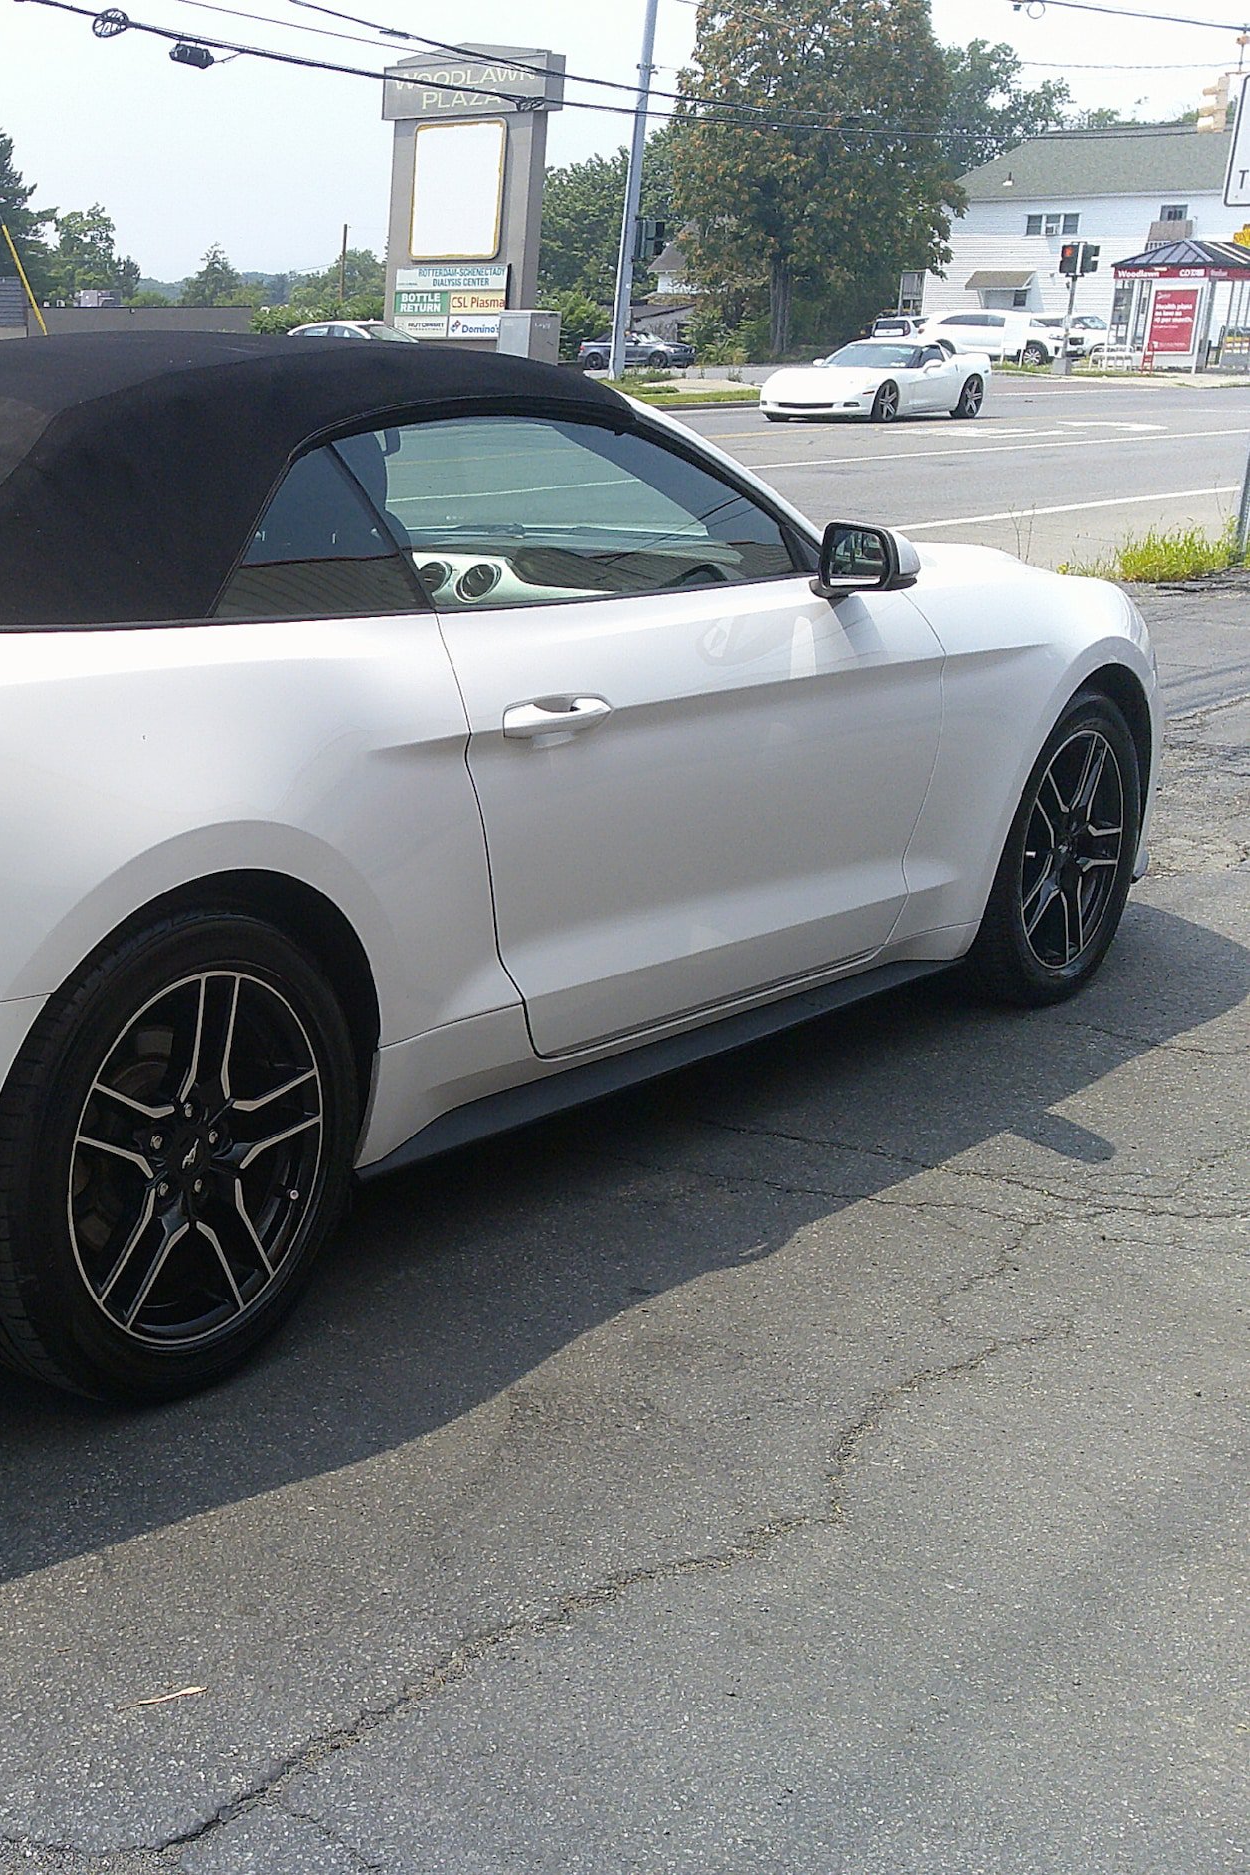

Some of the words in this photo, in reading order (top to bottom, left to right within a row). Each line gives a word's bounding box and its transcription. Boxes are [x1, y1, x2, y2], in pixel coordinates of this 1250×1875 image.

[394, 66, 536, 90] WOODLAWN
[421, 88, 502, 110] PLAZA
[1117, 269, 1160, 278] Woodlawn
[432, 278, 462, 287] DIALYSIS
[463, 277, 490, 287] CENTER
[401, 292, 441, 303] BOTTLE
[451, 296, 468, 308] CSL
[470, 296, 506, 309] Plasma
[400, 302, 441, 313] RETURN
